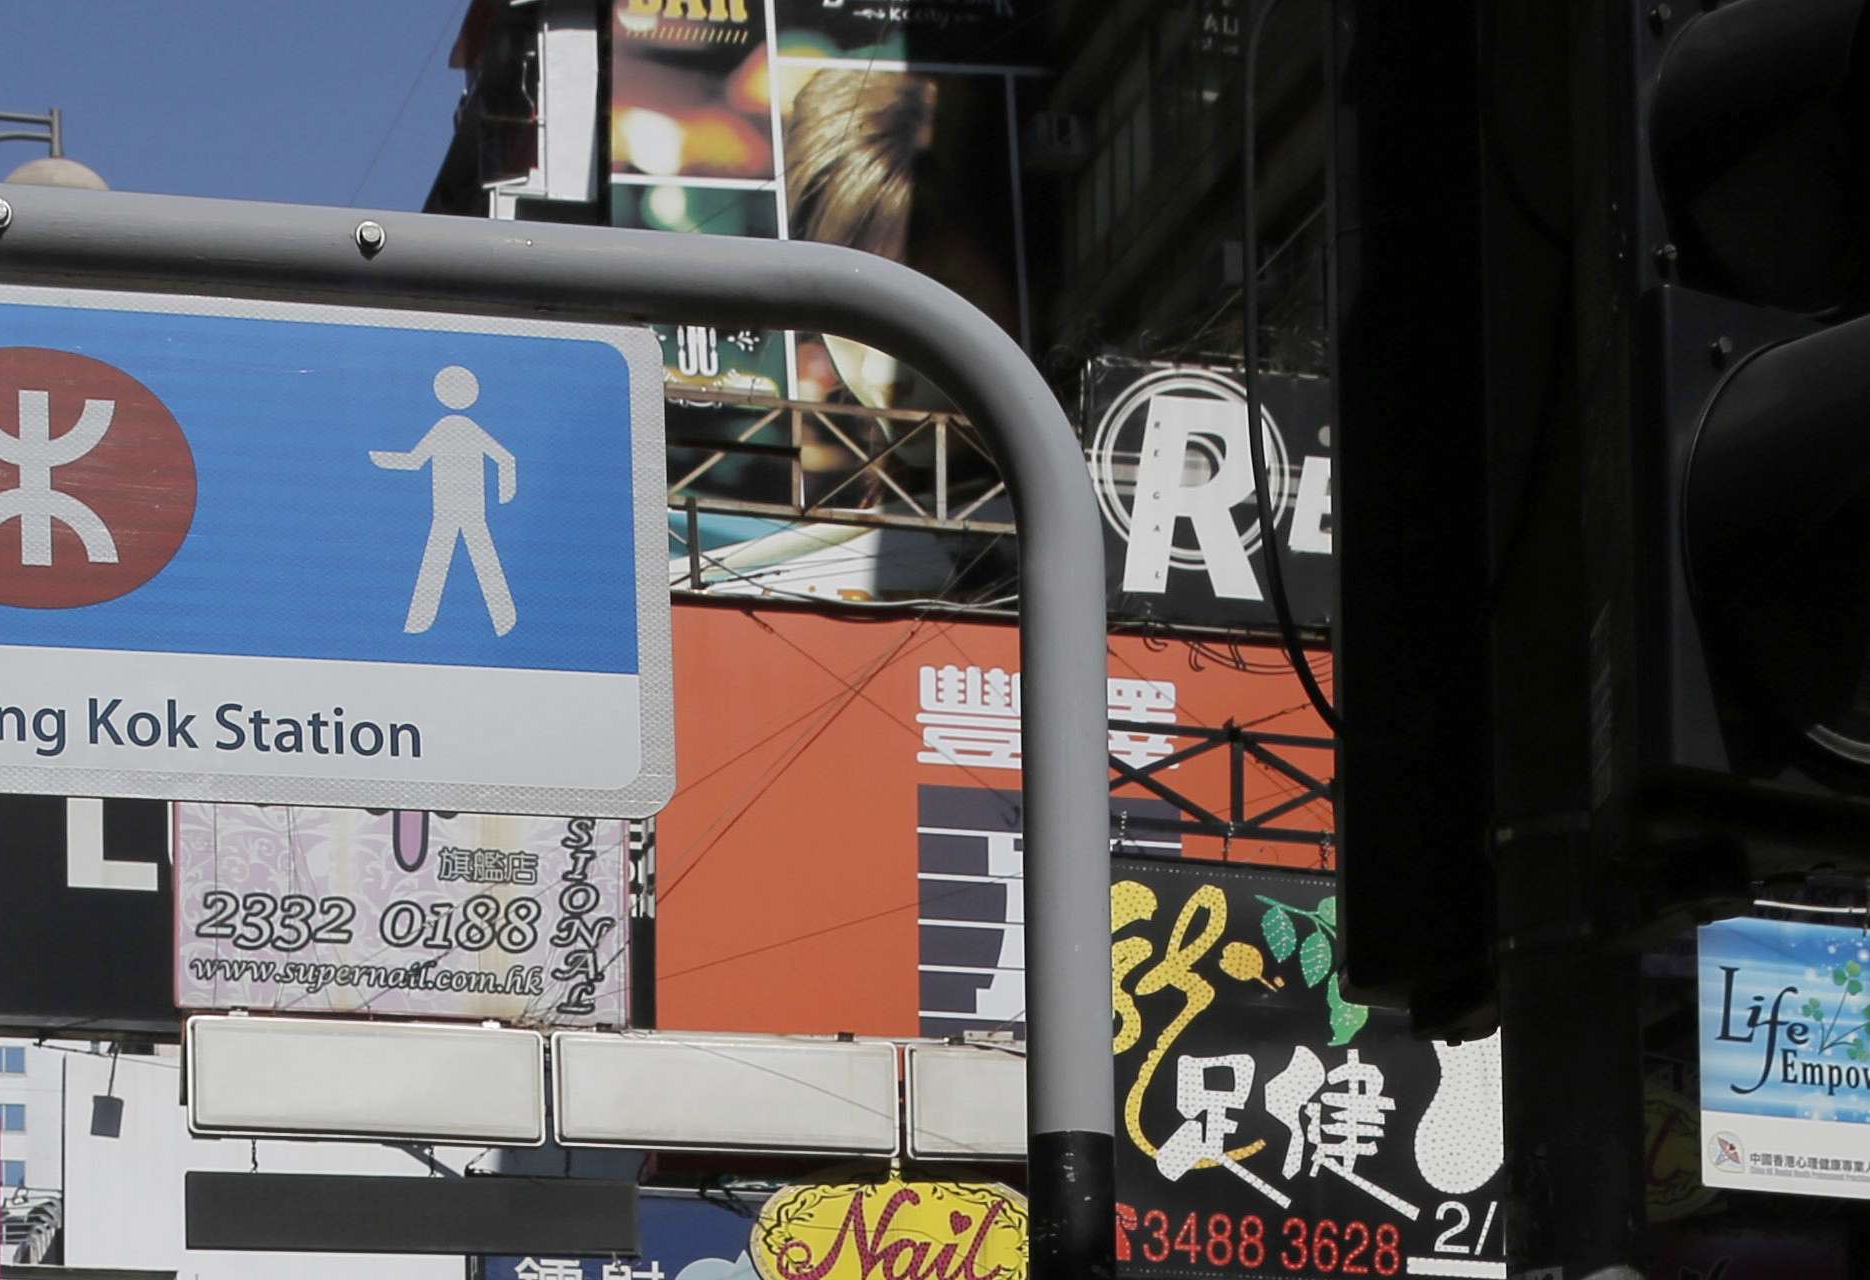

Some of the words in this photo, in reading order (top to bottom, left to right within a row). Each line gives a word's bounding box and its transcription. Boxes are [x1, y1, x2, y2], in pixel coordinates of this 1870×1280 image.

[88, 697, 199, 751] Kok
[214, 704, 423, 760] Station
[195, 891, 357, 951] 2332
[379, 896, 540, 953] 0188
[190, 954, 544, 997] www.supernail.com.hk
[1716, 965, 1809, 1094] Life
[1155, 1044, 1421, 1222] 足健
[1141, 1209, 1266, 1269] 3488
[1280, 1217, 1401, 1276] 3628
